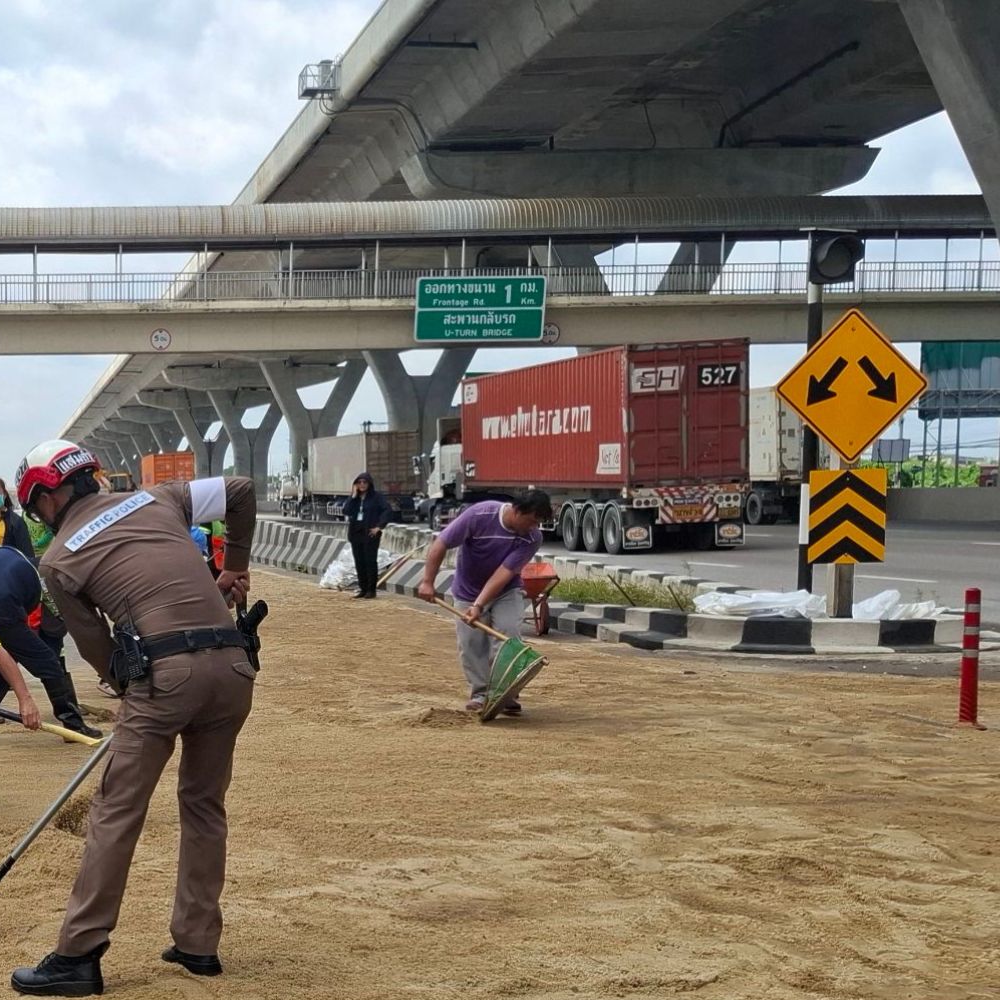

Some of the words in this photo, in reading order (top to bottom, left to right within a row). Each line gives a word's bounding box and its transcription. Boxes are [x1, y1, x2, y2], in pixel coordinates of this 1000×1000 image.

[424, 283, 496, 294] ออกทางขนาน
[504, 284, 512, 304] 1
[520, 283, 538, 293] กม.
[432, 299, 469, 307] Frontage
[443, 311, 516, 325] สะพานกลับรถ
[444, 329, 477, 337] U-TURN
[482, 328, 513, 337] BRIDGE
[701, 366, 737, 385] 527
[69, 513, 113, 546] TRAFFIC
[114, 494, 151, 517] POLICE
